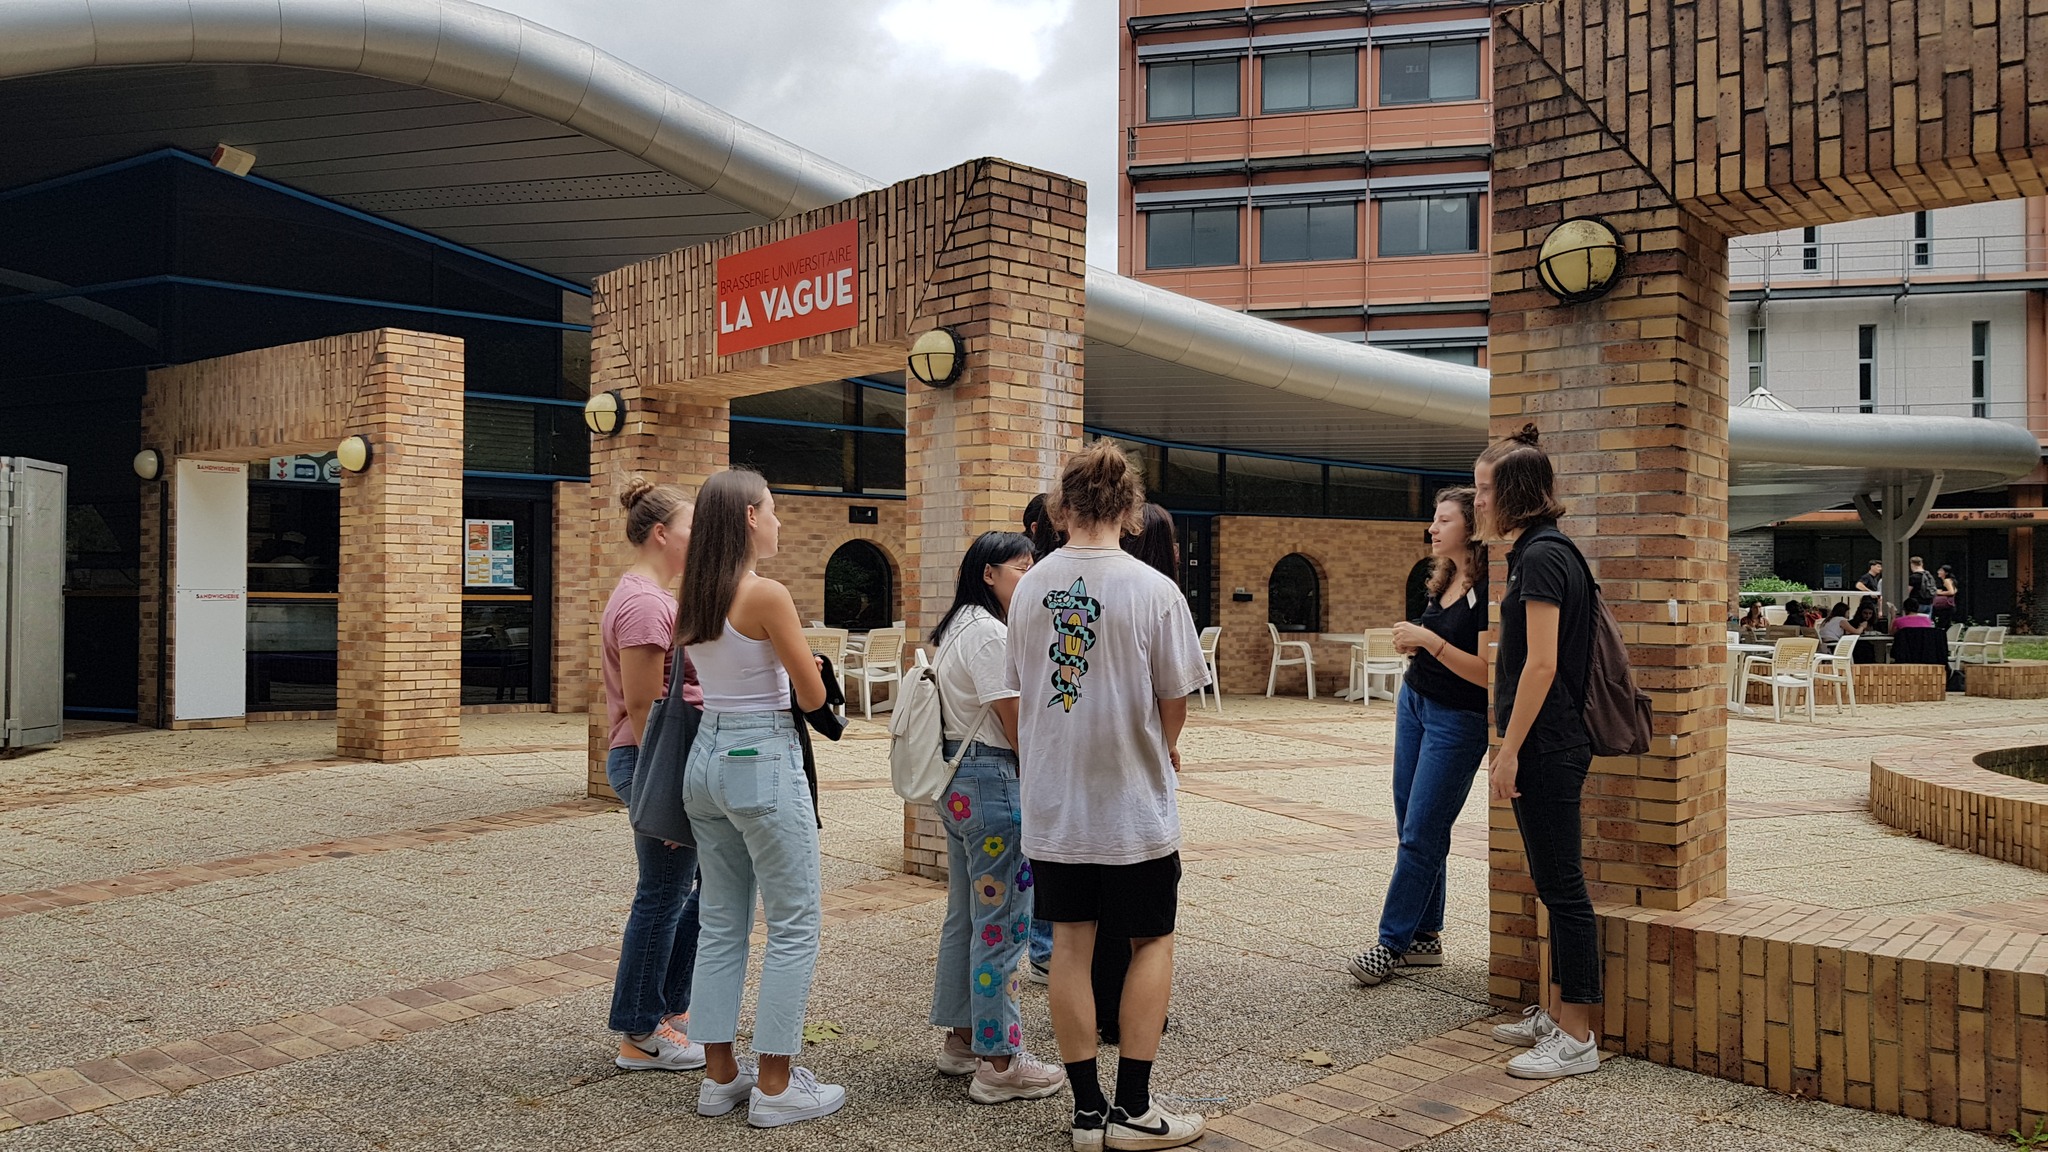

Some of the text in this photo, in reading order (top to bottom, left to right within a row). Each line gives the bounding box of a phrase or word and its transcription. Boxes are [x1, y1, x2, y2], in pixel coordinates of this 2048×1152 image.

[720, 245, 852, 296] BRASSERIE UNIVERSITAIRE
[720, 267, 853, 334] LA VAGUE
[197, 464, 241, 472] SANDWICHERIE
[1977, 511, 2035, 520] Techniques
